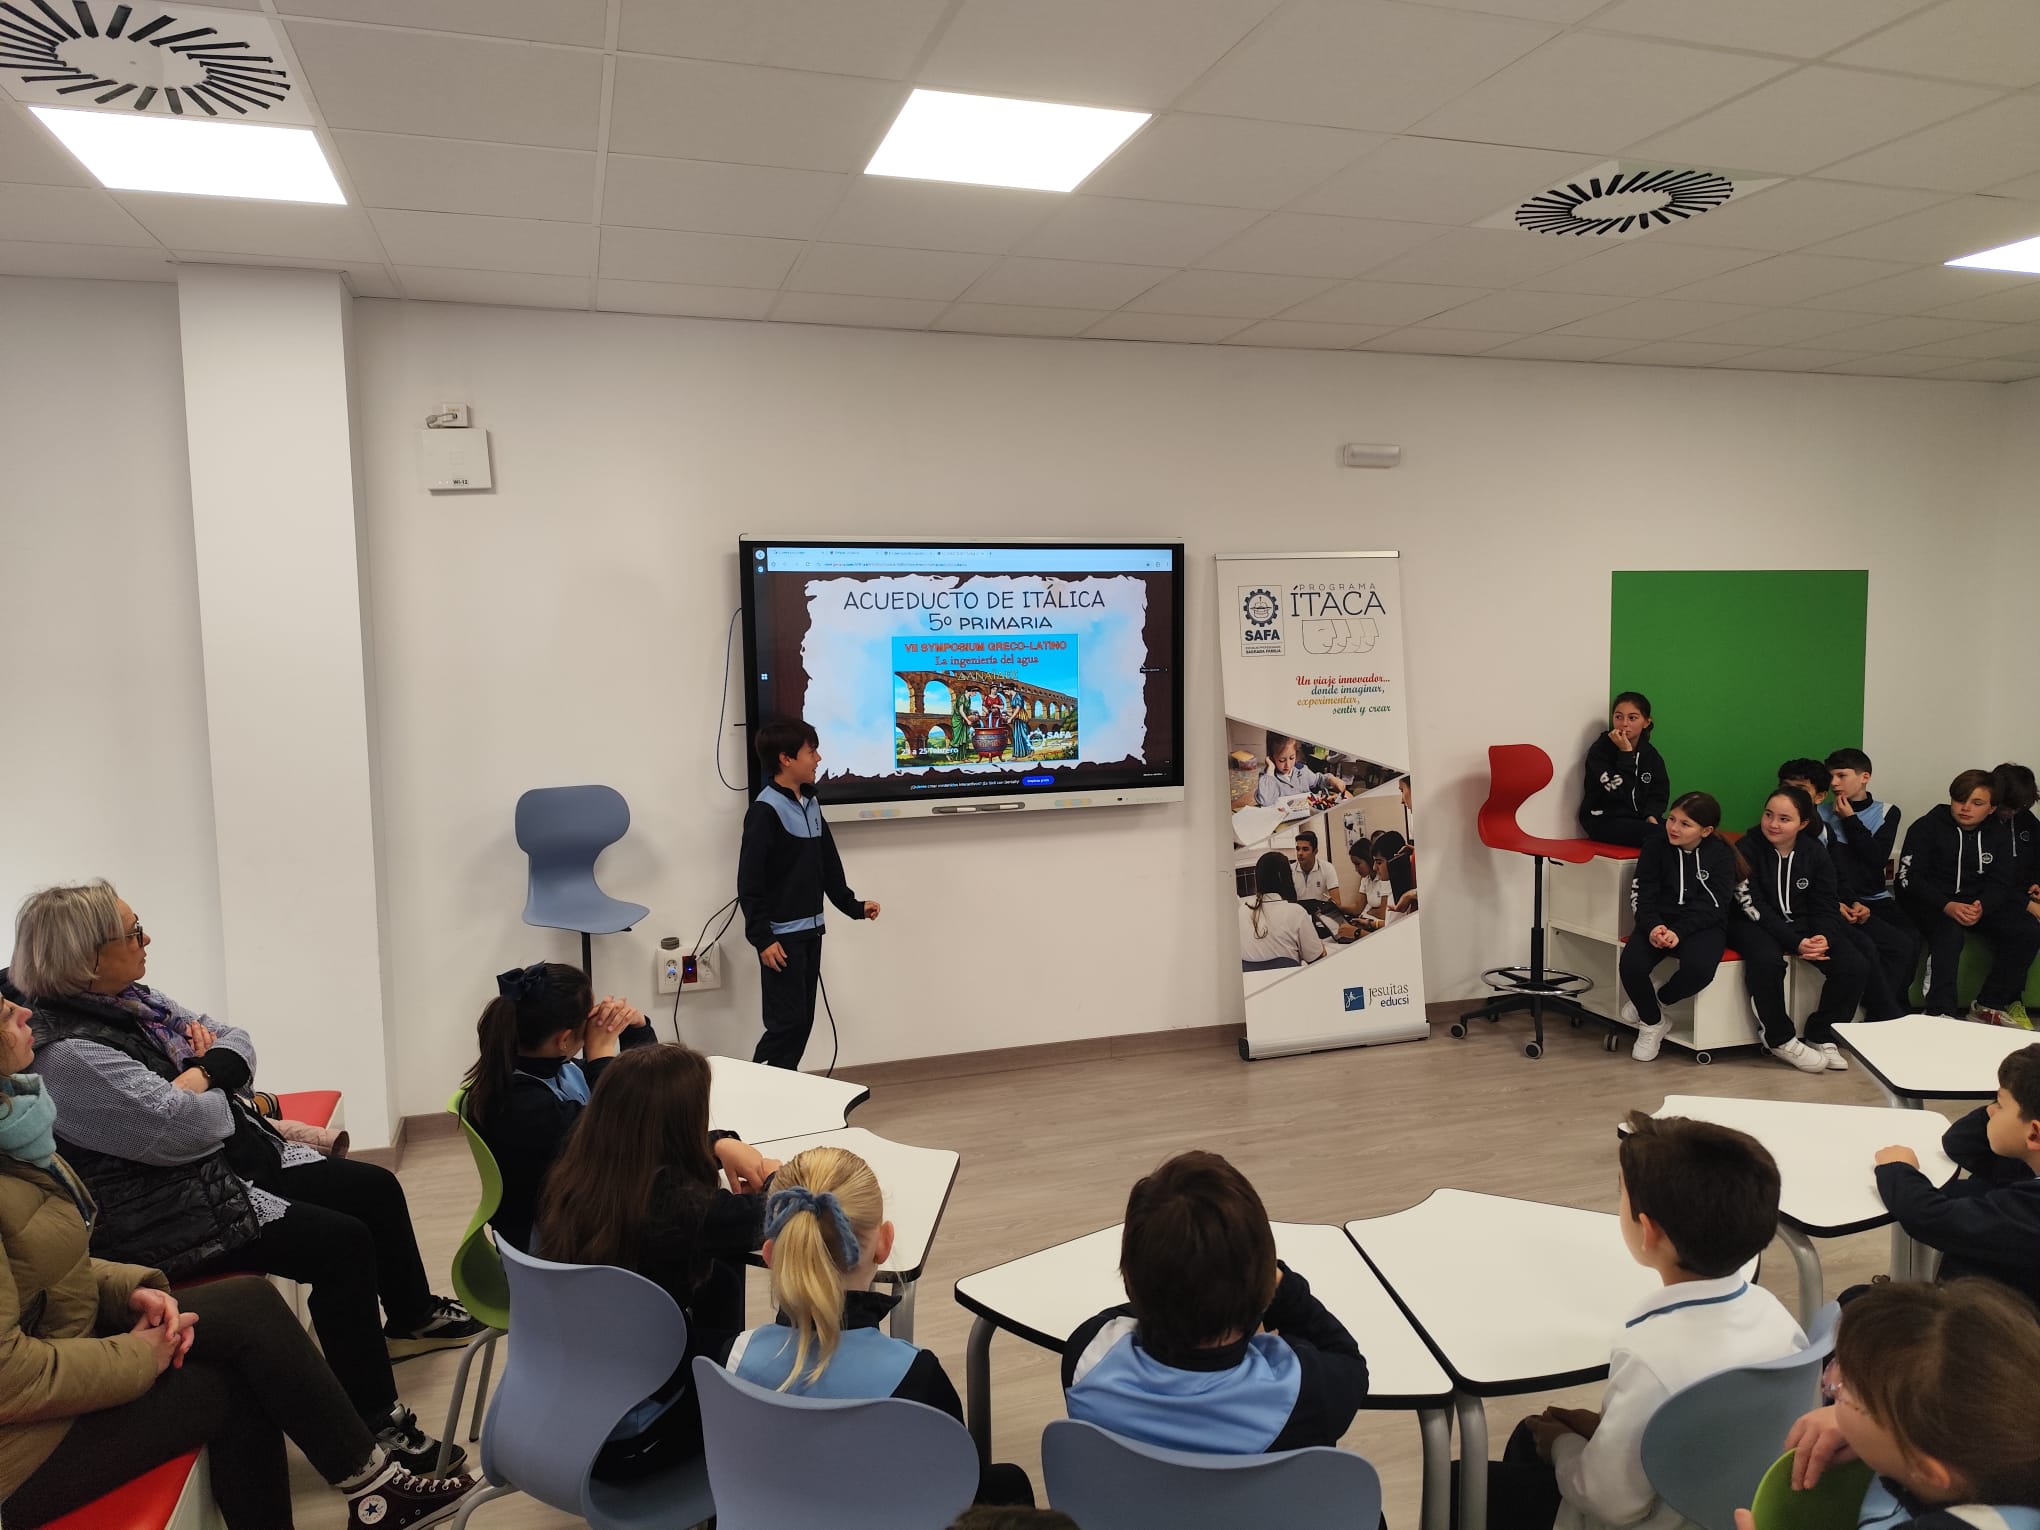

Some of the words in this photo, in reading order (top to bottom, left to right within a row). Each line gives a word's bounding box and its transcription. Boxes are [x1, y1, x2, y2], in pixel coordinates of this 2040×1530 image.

[1299, 582, 1376, 591] PROGRAMA
[843, 591, 979, 610] ACUEDUCTO
[987, 591, 1014, 609] DE
[1022, 584, 1106, 608] ITÁLICA
[1290, 585, 1386, 617] ÍTACA
[959, 616, 1053, 631] PRIMARIA
[1244, 629, 1281, 641] SAFA
[921, 642, 985, 653] SYMPOSIUM
[987, 640, 1067, 651] GRECO-LATINO
[935, 656, 947, 666] La
[950, 655, 998, 668] ingeniería
[1000, 653, 1014, 664] del
[1016, 656, 1039, 667] agua
[1295, 675, 1311, 685] Un
[1313, 676, 1336, 687] viaje
[1338, 673, 1390, 684] innovador...
[1311, 685, 1339, 695] donde
[1340, 685, 1385, 696] imaginar,
[1297, 695, 1360, 708] experimentar,
[1332, 704, 1357, 715] sentir
[1359, 706, 1366, 717] y
[1380, 994, 1410, 1007] educsi
